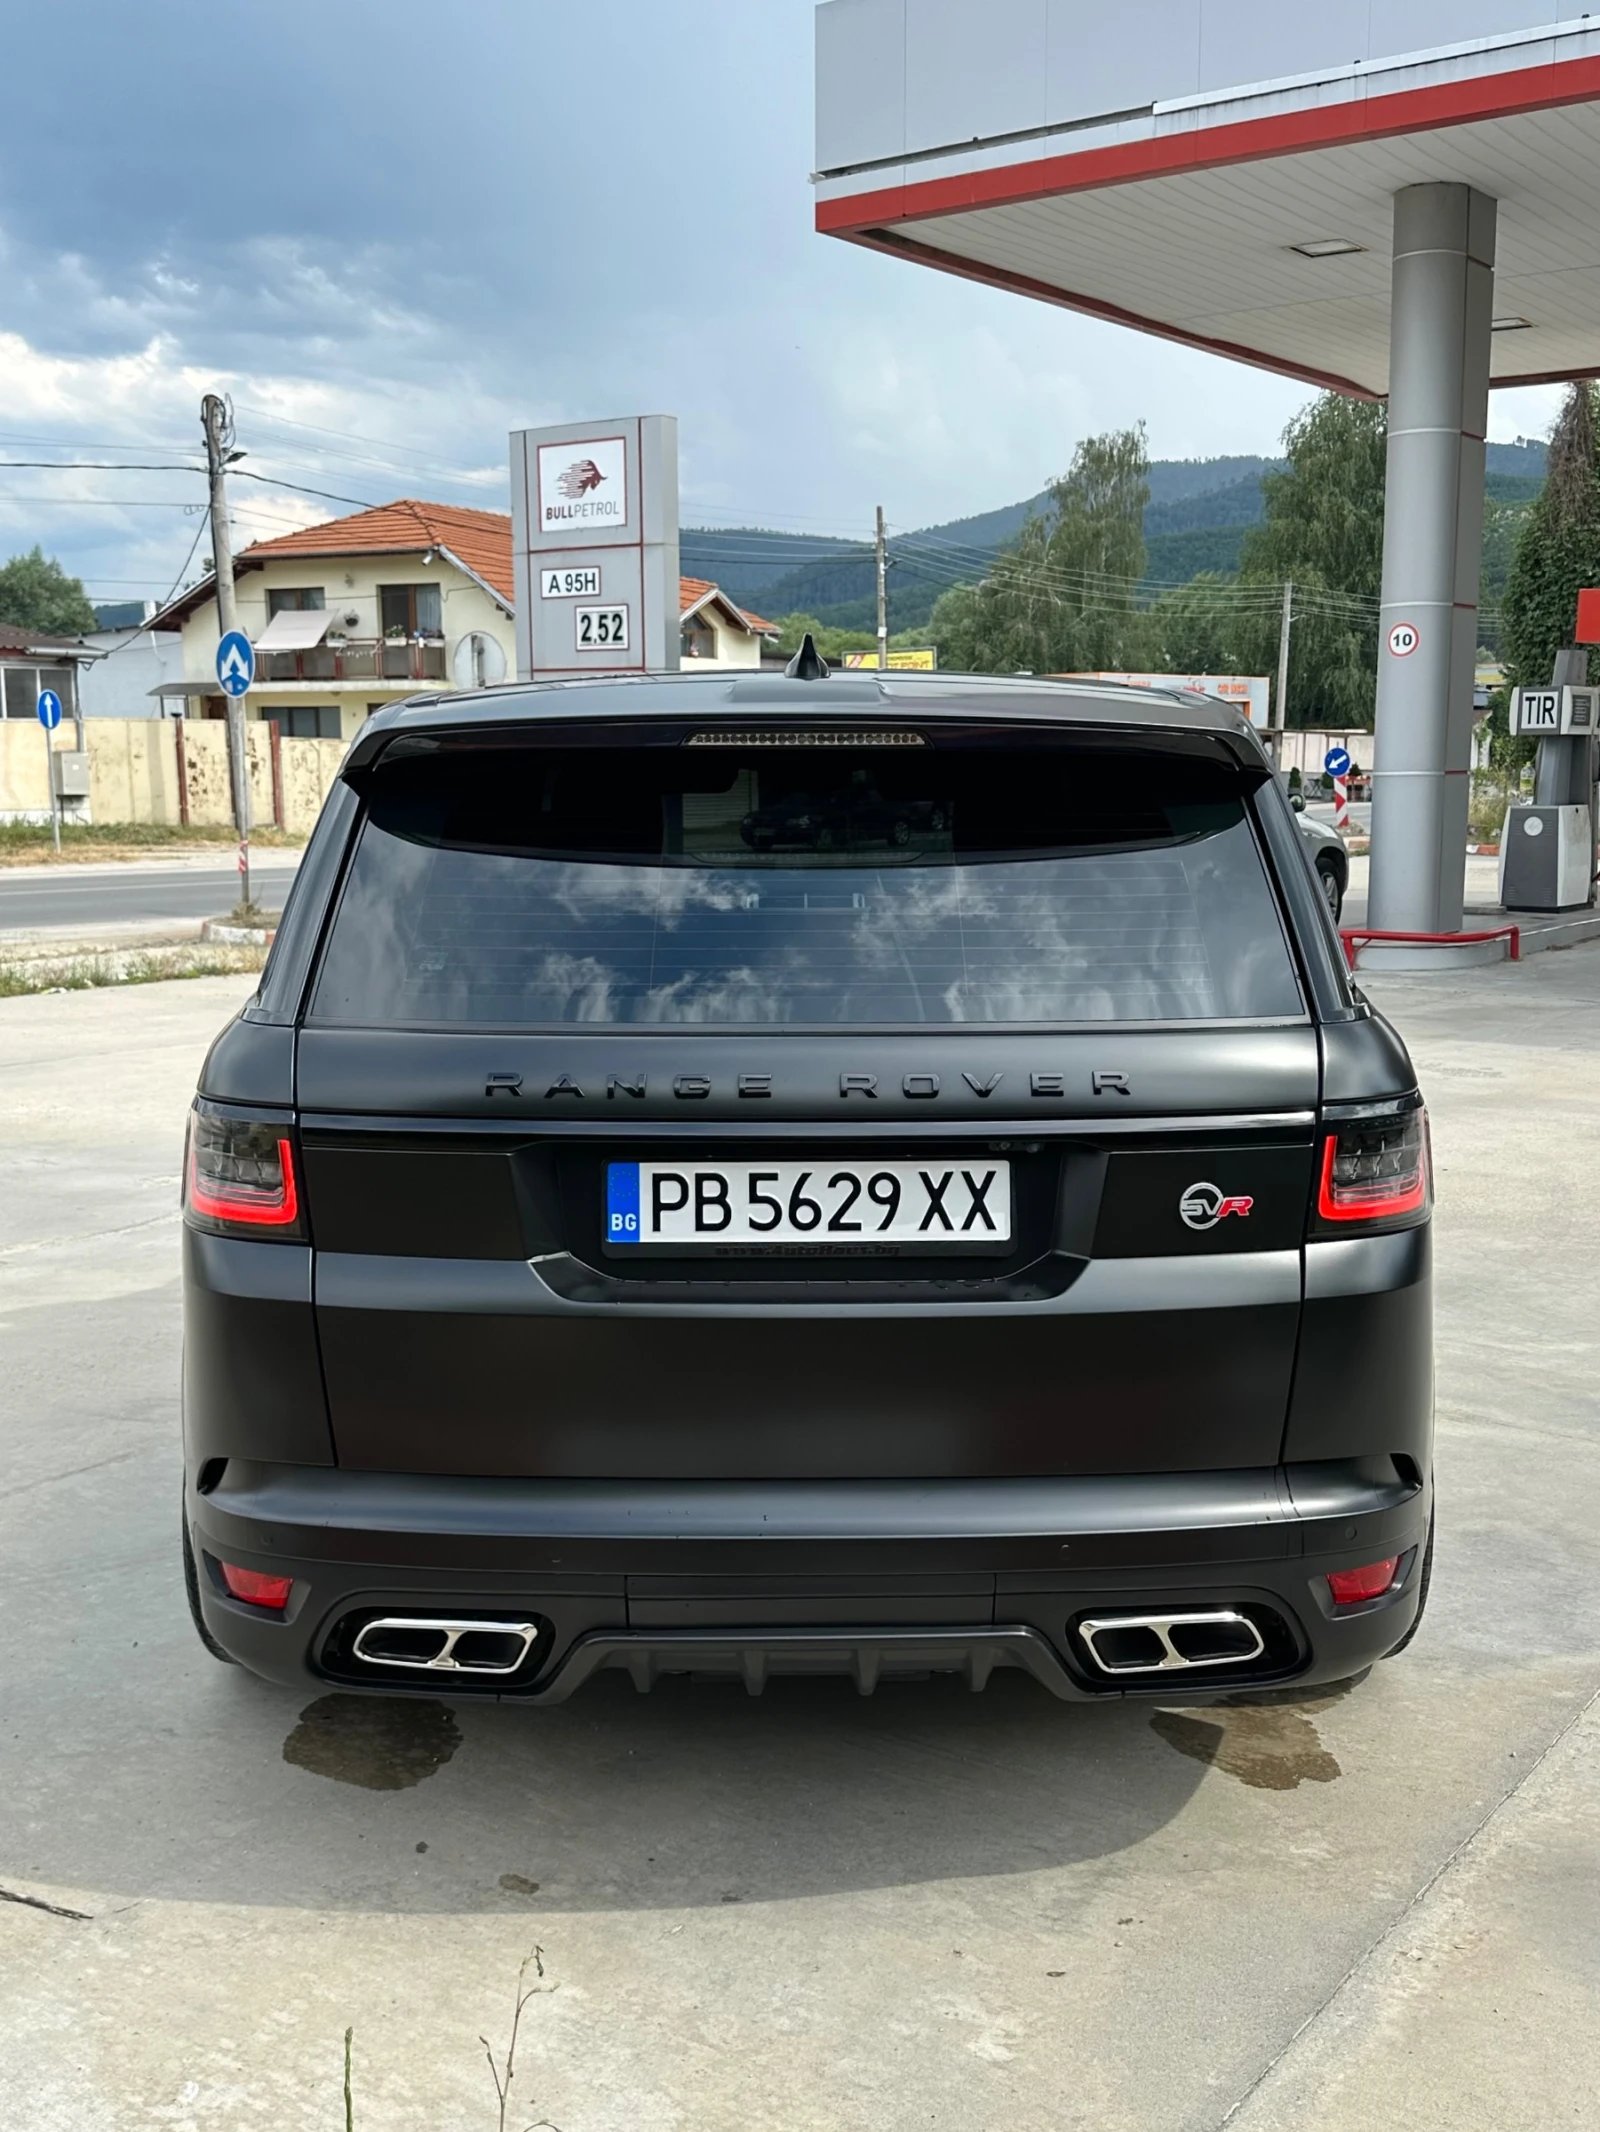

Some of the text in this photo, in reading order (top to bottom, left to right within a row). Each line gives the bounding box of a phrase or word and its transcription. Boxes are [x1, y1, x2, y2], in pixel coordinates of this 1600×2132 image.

[545, 501, 619, 520] BULLPETROL
[548, 572, 596, 593] A 95H
[1393, 634, 1413, 647] 10
[1525, 696, 1555, 725] TIR
[485, 1071, 1131, 1099] RANGE ROVER
[651, 1170, 997, 1233] PB 5629 XX
[611, 1213, 637, 1231] BG
[715, 1243, 902, 1257] www.AutoHaus.bg
